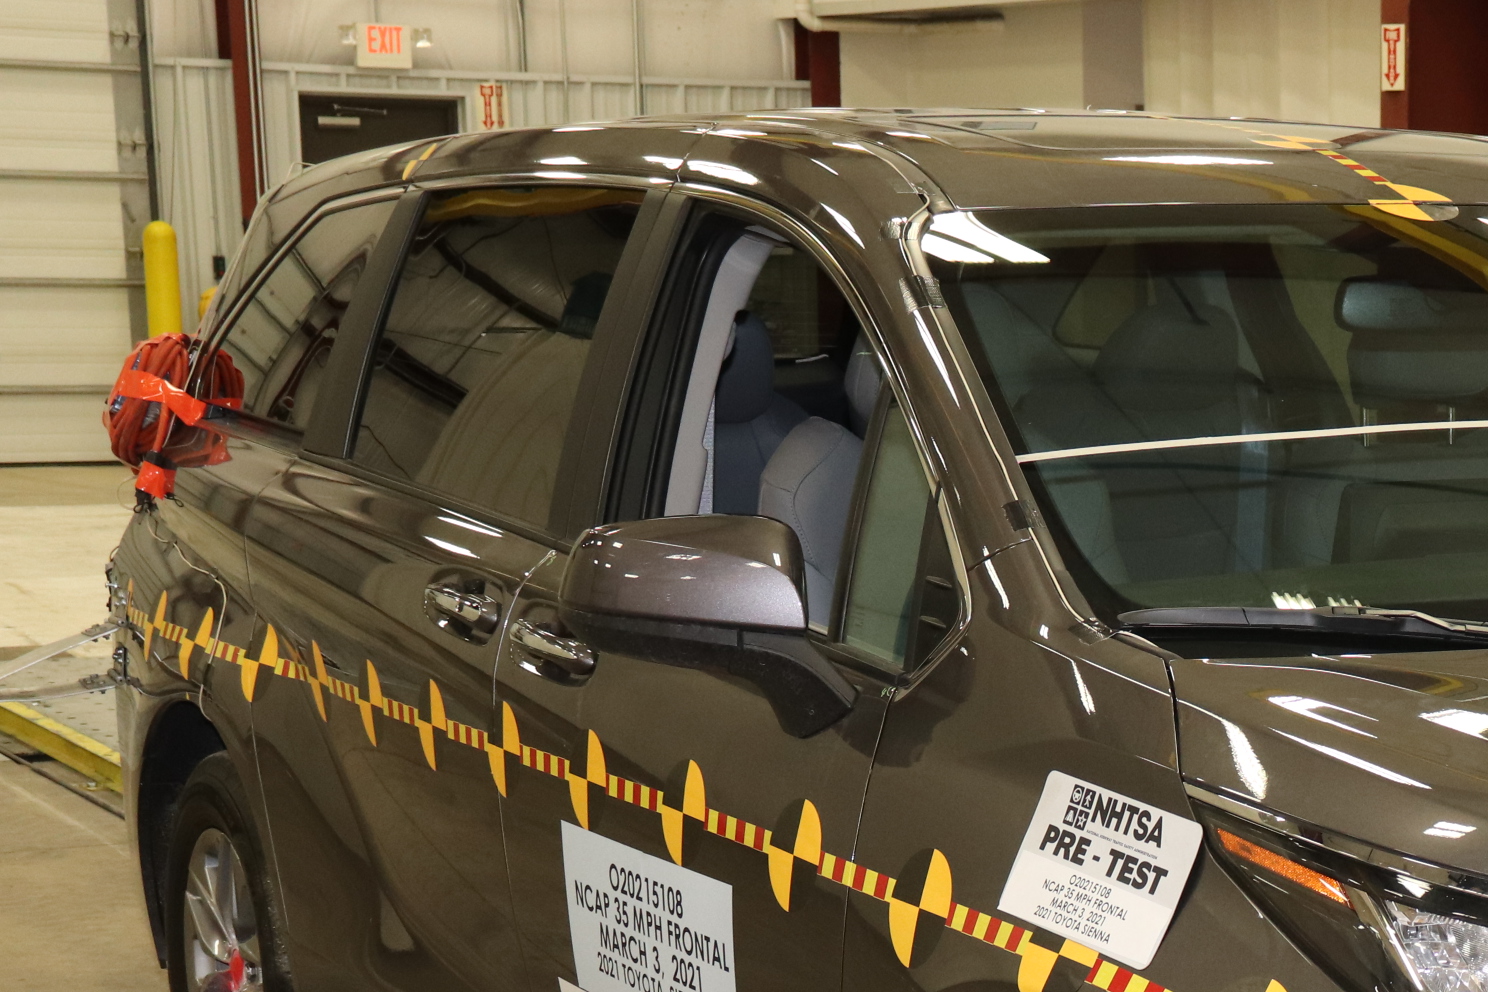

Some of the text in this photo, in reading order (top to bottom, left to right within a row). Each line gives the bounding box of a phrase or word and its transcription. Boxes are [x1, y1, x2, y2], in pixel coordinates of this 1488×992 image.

[366, 25, 403, 54] EXIT
[1090, 792, 1163, 849] NHTSA
[1039, 824, 1092, 866] PRE
[1105, 848, 1169, 895] TEST
[1042, 878, 1128, 921] NCAP 35 MPH FRONTAL
[1049, 897, 1107, 927] MARCH 3, 2021
[574, 880, 730, 973] NCAP 35 MPH FRONTAL
[1033, 905, 1111, 945] 2021 TOYOTA SIENNA
[597, 951, 620, 981] 2021
[599, 921, 648, 969] MARCH
[652, 946, 665, 980] 3,
